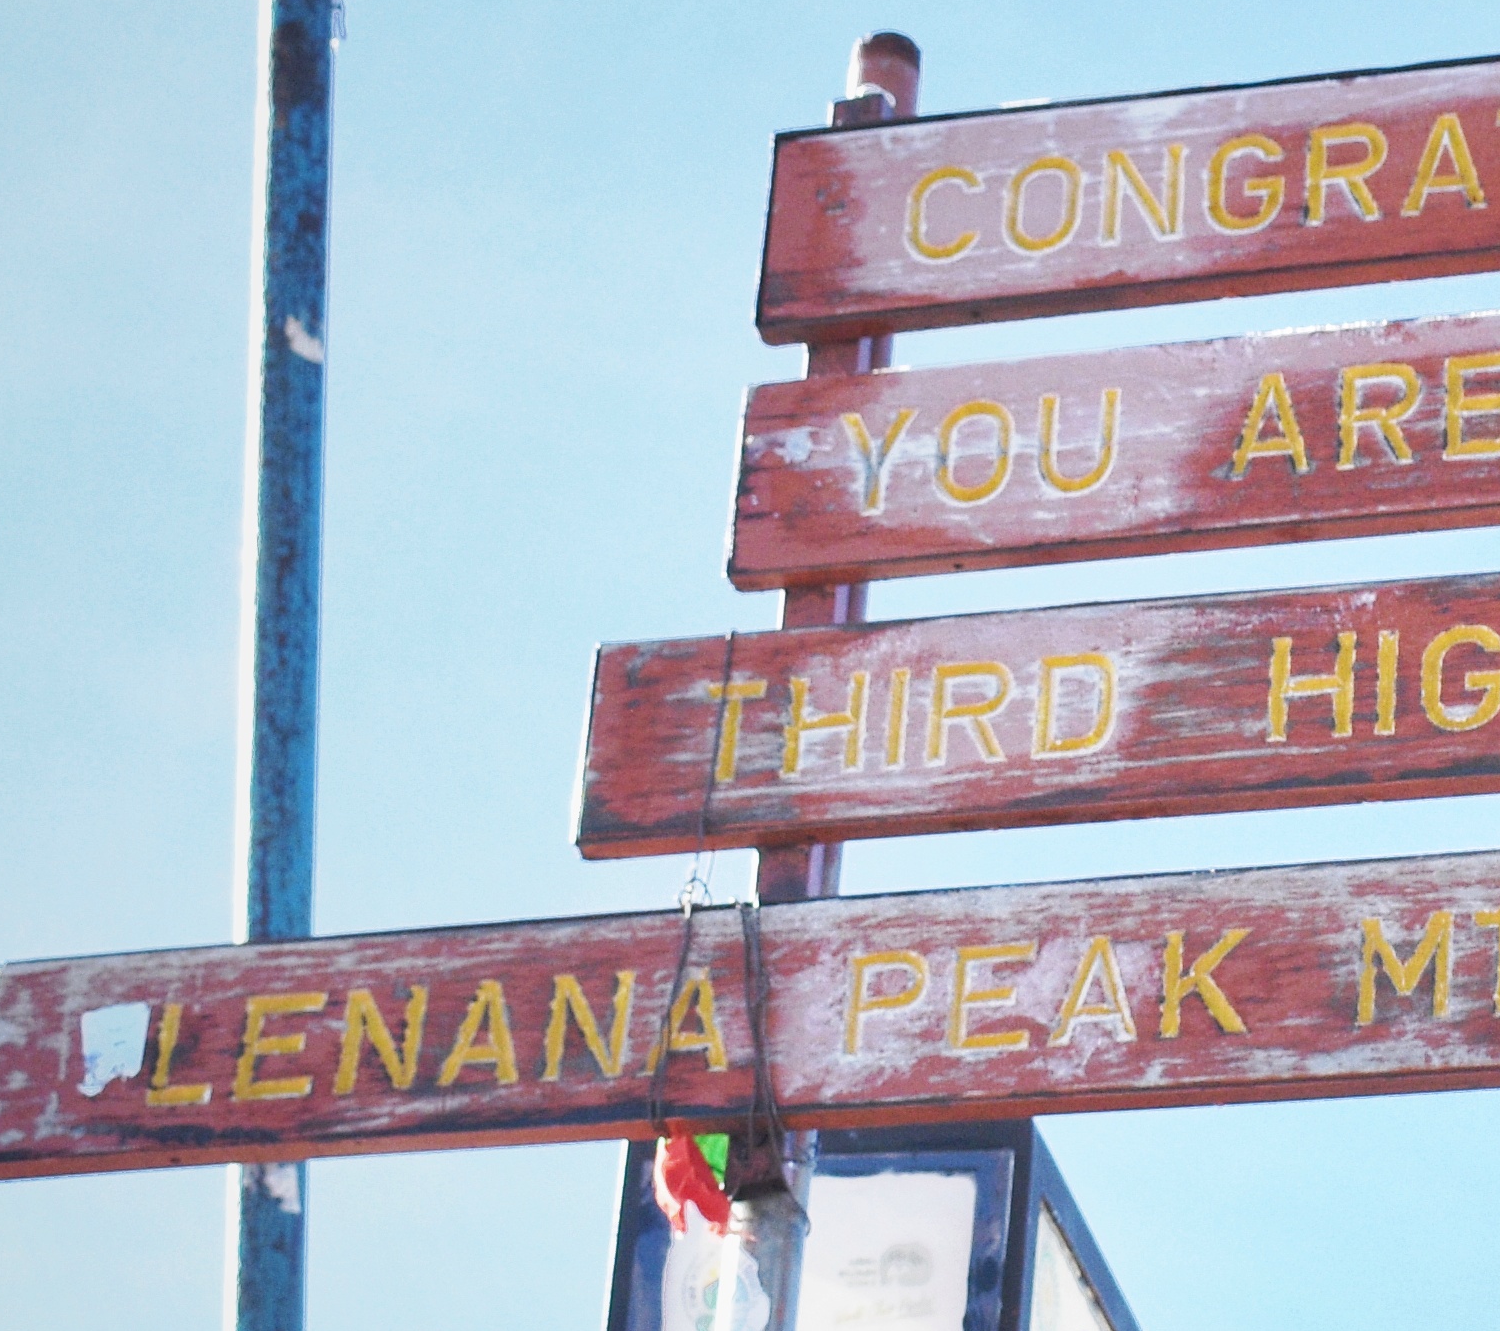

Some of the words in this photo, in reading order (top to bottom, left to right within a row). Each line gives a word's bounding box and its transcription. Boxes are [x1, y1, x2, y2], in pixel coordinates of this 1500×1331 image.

[842, 388, 1122, 516] YOU
[708, 650, 1122, 782] THIRD
[144, 969, 730, 1106] LENANA
[842, 926, 1253, 1055] PEAK
